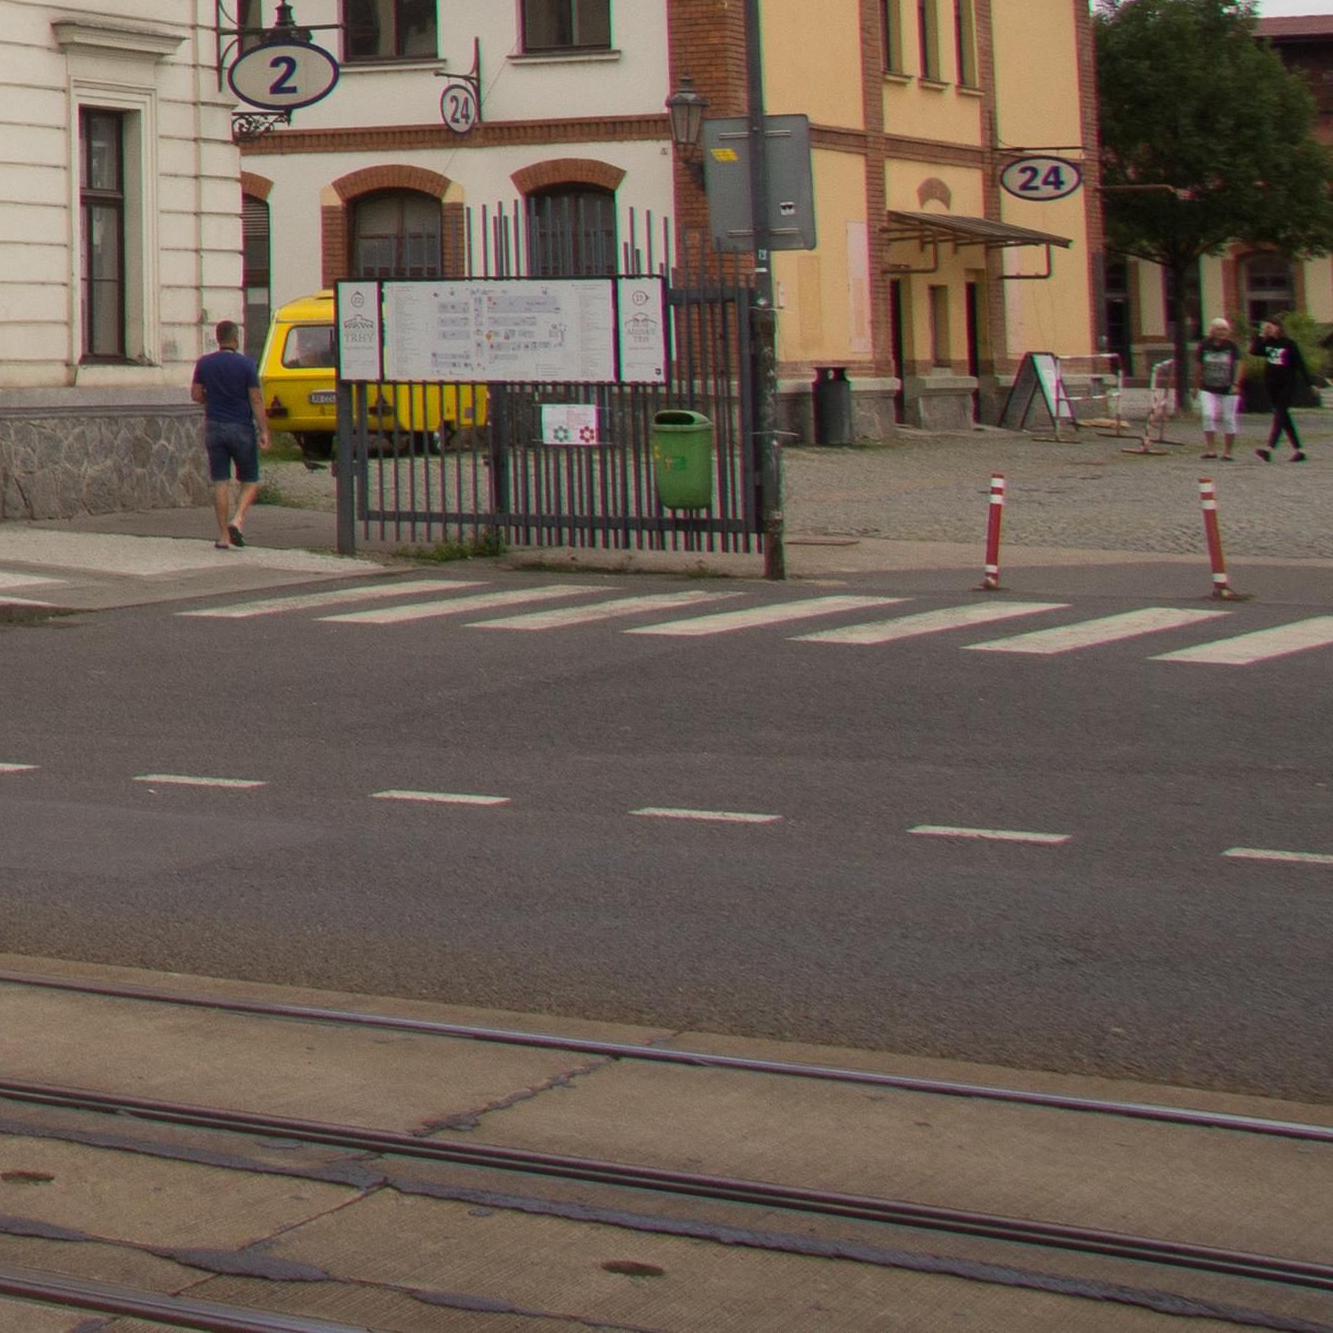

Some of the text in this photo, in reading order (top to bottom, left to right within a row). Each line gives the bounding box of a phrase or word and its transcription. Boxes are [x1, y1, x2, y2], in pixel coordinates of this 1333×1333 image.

[269, 55, 298, 95] 2
[449, 95, 470, 124] 24
[1018, 166, 1064, 191] 24
